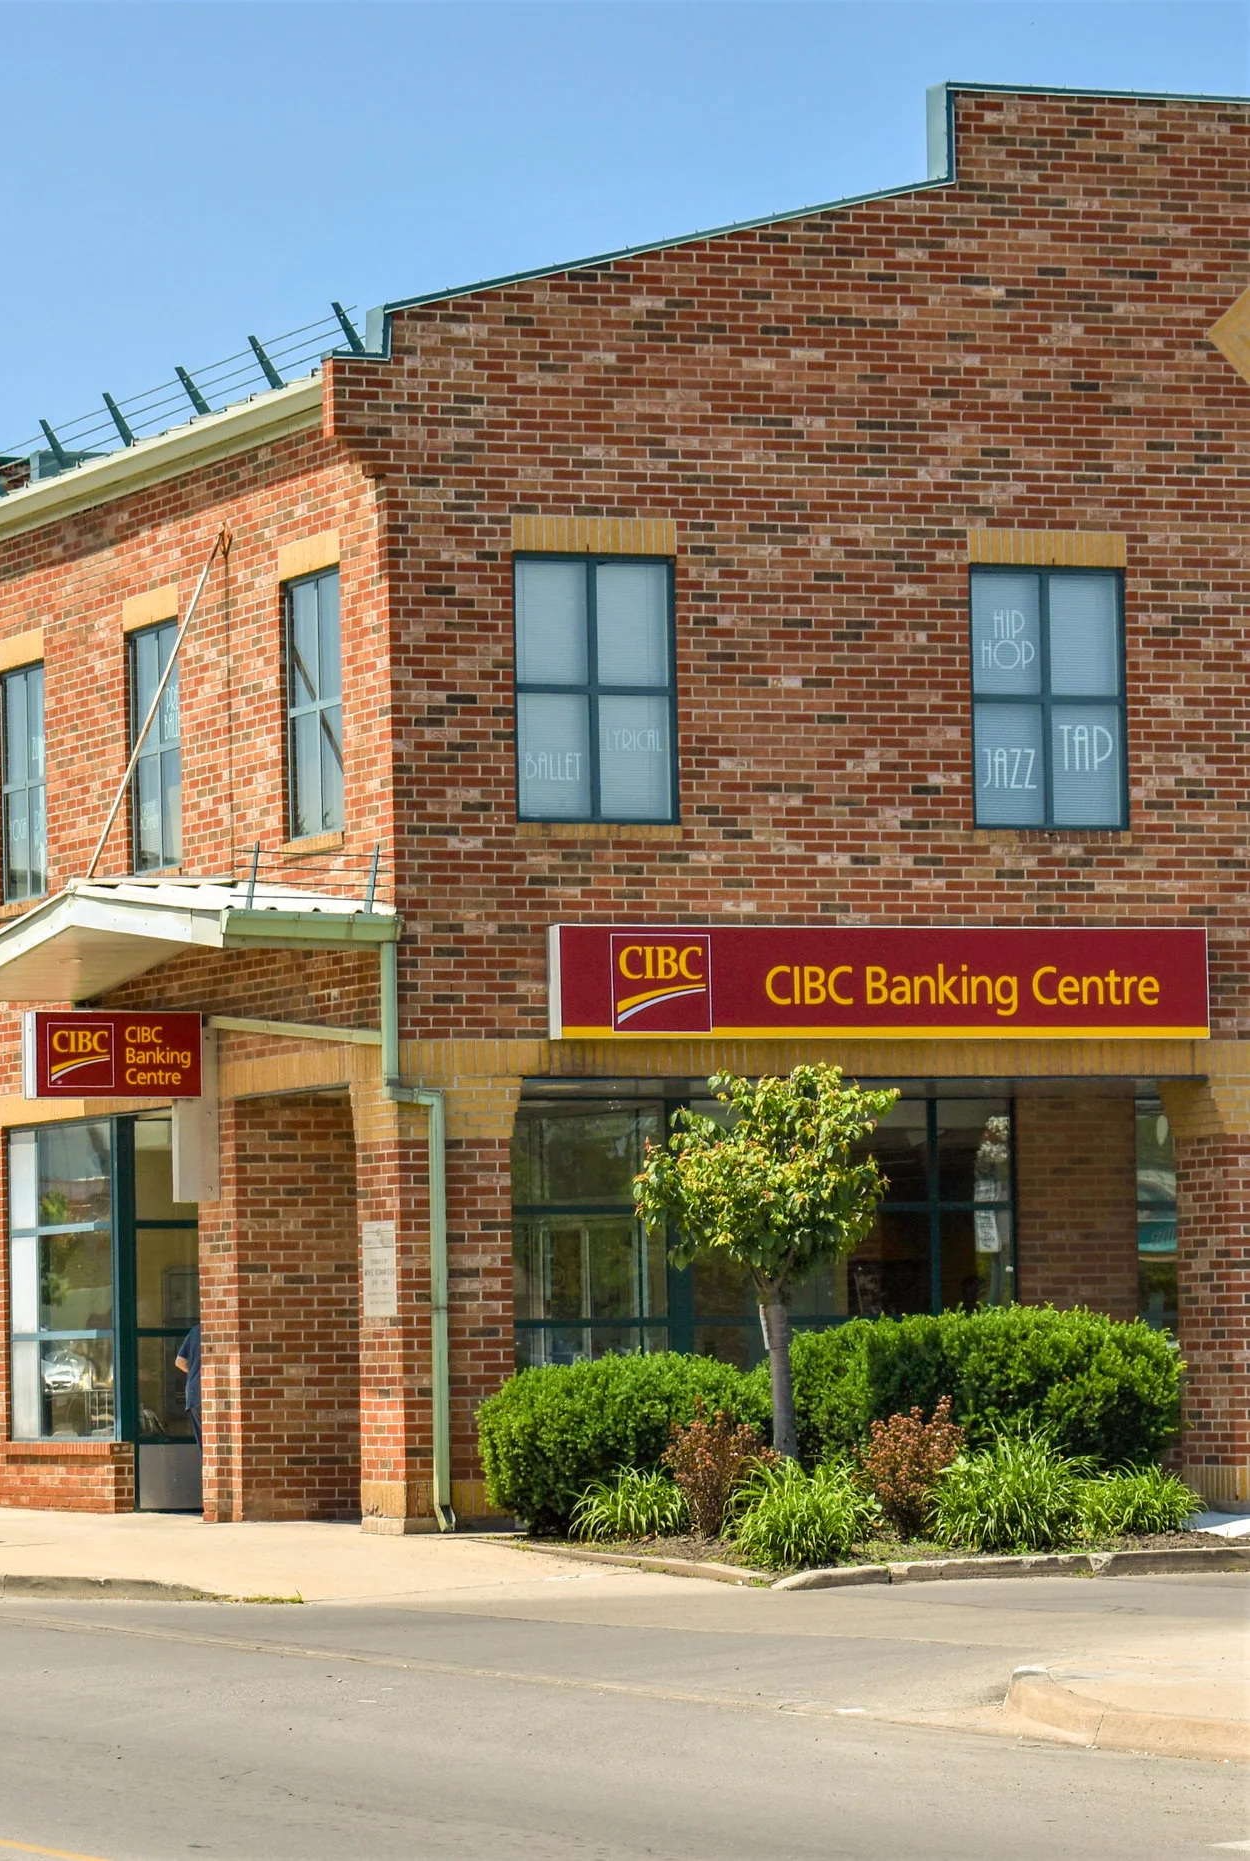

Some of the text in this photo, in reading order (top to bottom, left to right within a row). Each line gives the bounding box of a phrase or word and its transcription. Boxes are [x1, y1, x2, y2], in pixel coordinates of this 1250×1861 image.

[993, 608, 1025, 639] HIP
[981, 639, 1035, 670] HOP
[606, 727, 664, 751] LYRICAL
[1058, 724, 1113, 771] TAP
[525, 751, 583, 782] BALLET
[982, 747, 1038, 789] JAZZ
[618, 945, 703, 981] CIBC
[765, 962, 1160, 1017] CIBC Banking Centre
[52, 1030, 109, 1054] CIBC
[125, 1026, 163, 1044] CIBC
[125, 1046, 192, 1069] Banking
[125, 1068, 182, 1086] Centre
